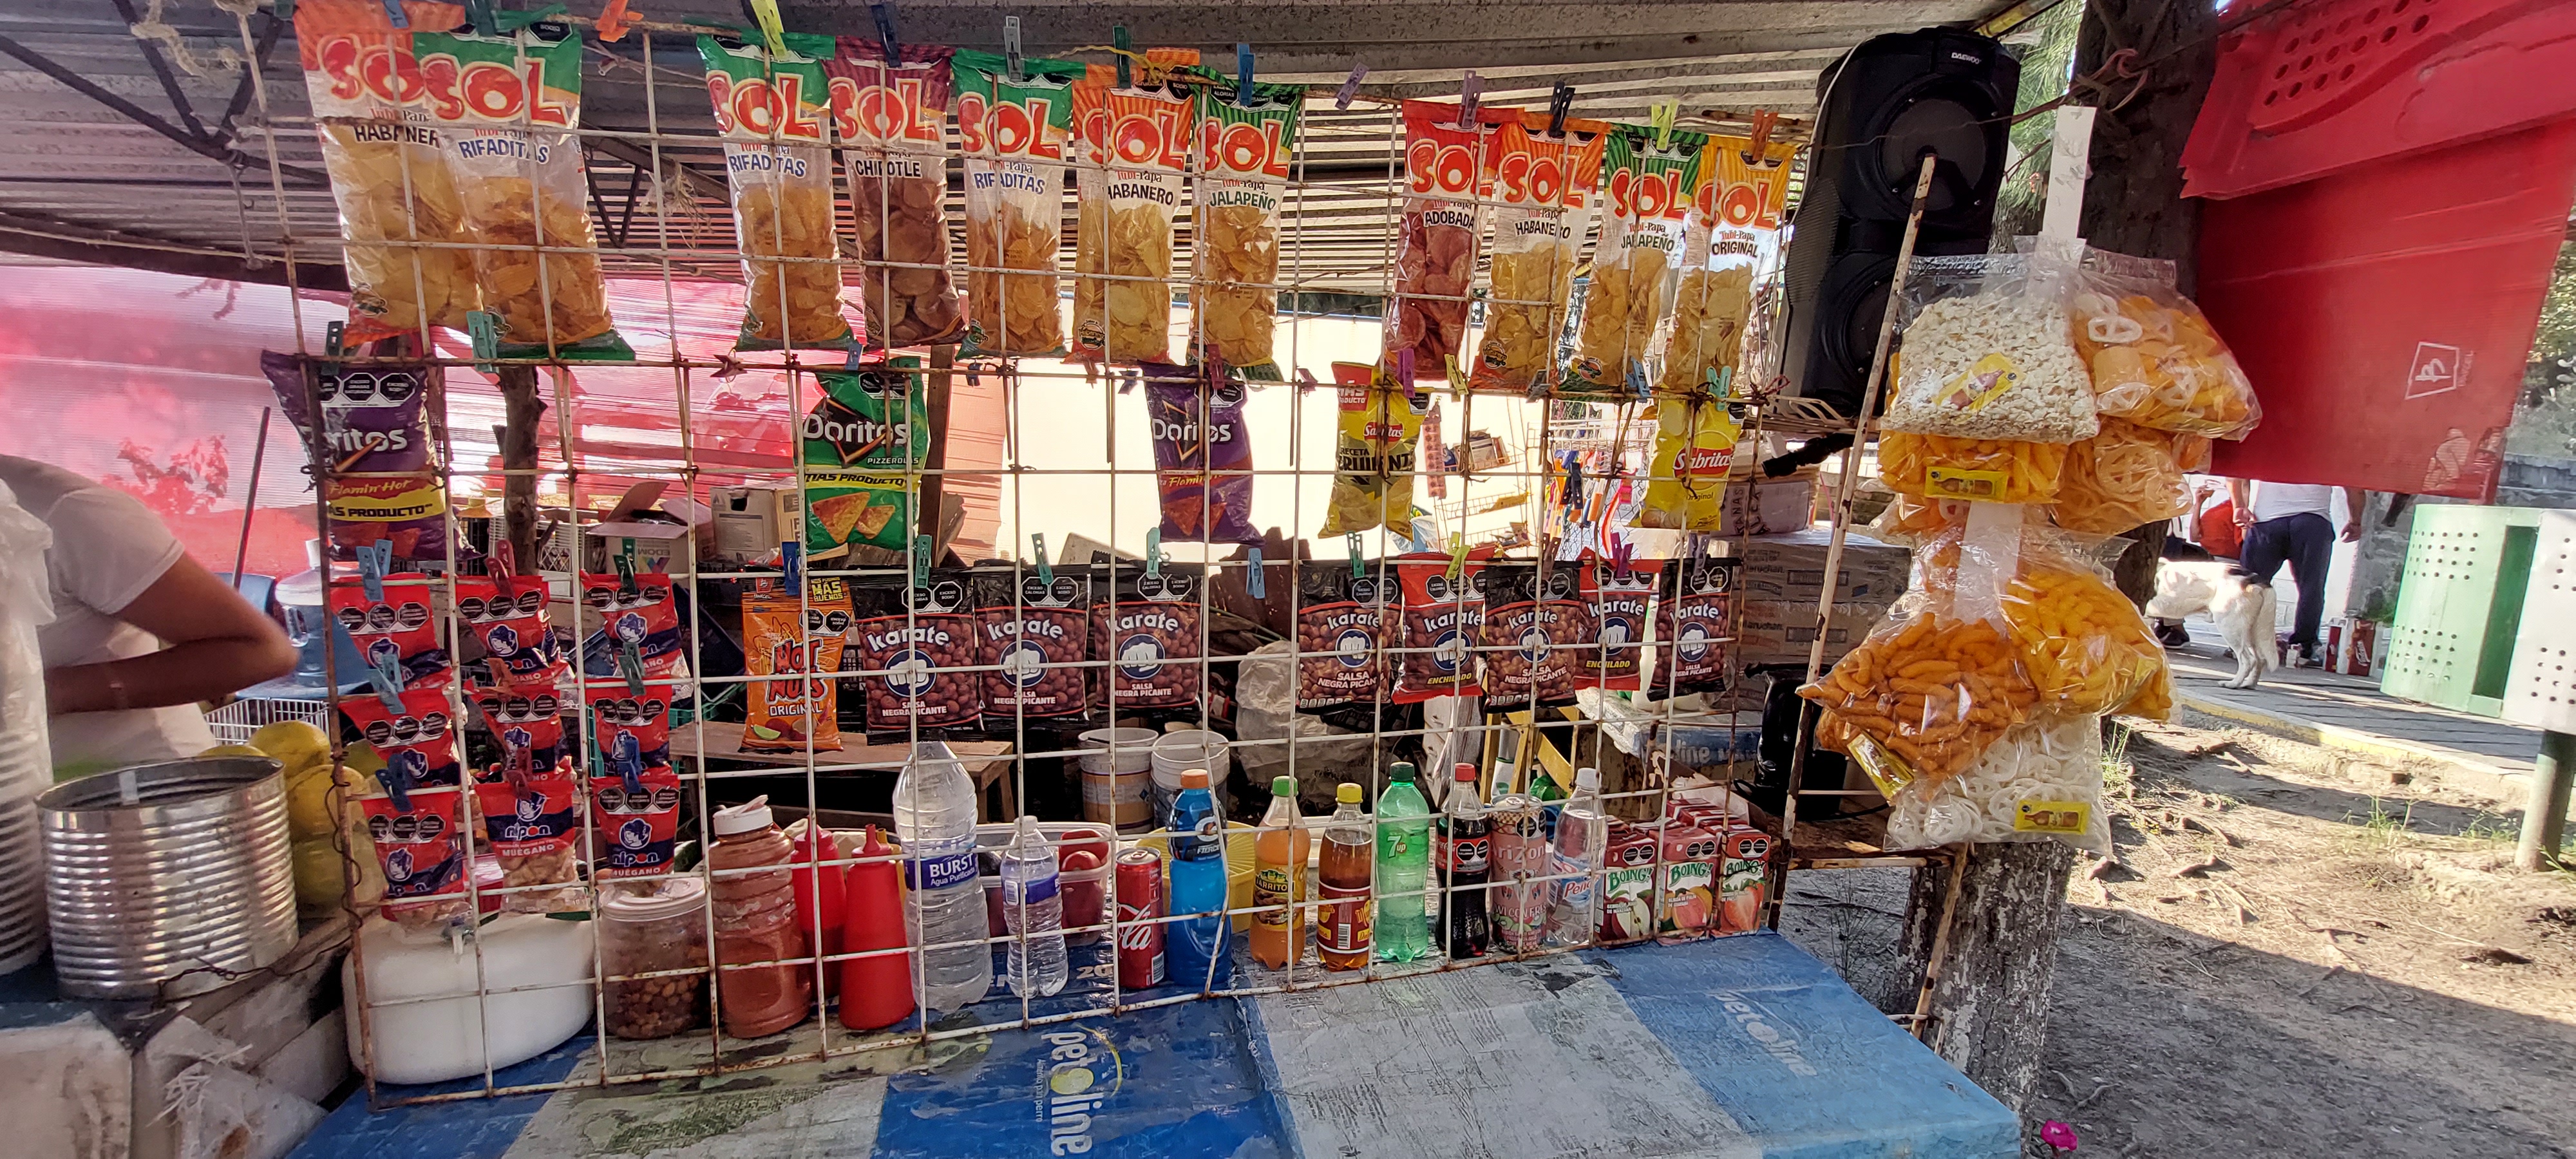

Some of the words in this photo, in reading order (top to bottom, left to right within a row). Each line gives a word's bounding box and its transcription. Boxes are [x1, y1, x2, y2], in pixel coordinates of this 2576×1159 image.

[1951, 52, 1980, 64] DAEWOO
[319, 35, 425, 106] SO
[421, 53, 568, 126] SOL
[707, 71, 822, 140] SOL
[829, 77, 940, 142] SOL
[958, 91, 1061, 160] SOL
[1083, 108, 1186, 172] SOL
[1194, 115, 1289, 178] SOL
[728, 154, 806, 178] RIFADTAS
[1408, 139, 1495, 199] SOL
[973, 172, 1046, 195] RIFADITAS
[1499, 150, 1586, 209] SOL
[1208, 188, 1277, 212] JALAPEÑO
[1611, 167, 1689, 221] SOL
[1696, 179, 1778, 231] SOL
[1718, 229, 1756, 241] Tubi-Papa
[1710, 241, 1759, 258] ORIGINAL
[803, 414, 908, 445] Doritos
[1152, 419, 1232, 442] Dorios
[1674, 452, 1733, 470] Sabritas
[383, 478, 414, 493] Hot
[838, 474, 905, 487] PRODUCTO
[1686, 492, 1714, 502] Original
[348, 505, 425, 517] PRODUCTO
[812, 581, 842, 596] MÁS
[813, 593, 844, 602] BUENOS
[986, 617, 1064, 642] karate
[1327, 612, 1381, 630] karate
[866, 626, 951, 652] karate
[773, 638, 823, 673] HOT
[1336, 671, 1370, 681] SALSA
[1427, 673, 1472, 684] ENCHILDO
[1504, 675, 1533, 684] NEGRA
[1690, 666, 1713, 676] PICANTE
[765, 671, 829, 702] NUS
[1141, 688, 1172, 697] PICANTE
[1318, 678, 1349, 689] NEGRA
[902, 701, 926, 709] SASA
[1023, 697, 1056, 705] PICANTE
[929, 853, 974, 879] BURST
[931, 877, 948, 887] Agua
[950, 866, 976, 882] Purificada
[1670, 862, 1716, 889] BOING!
[1726, 860, 1766, 876] BOING!
[1607, 867, 1654, 894] BOING!
[1034, 1099, 1045, 1123] perro
